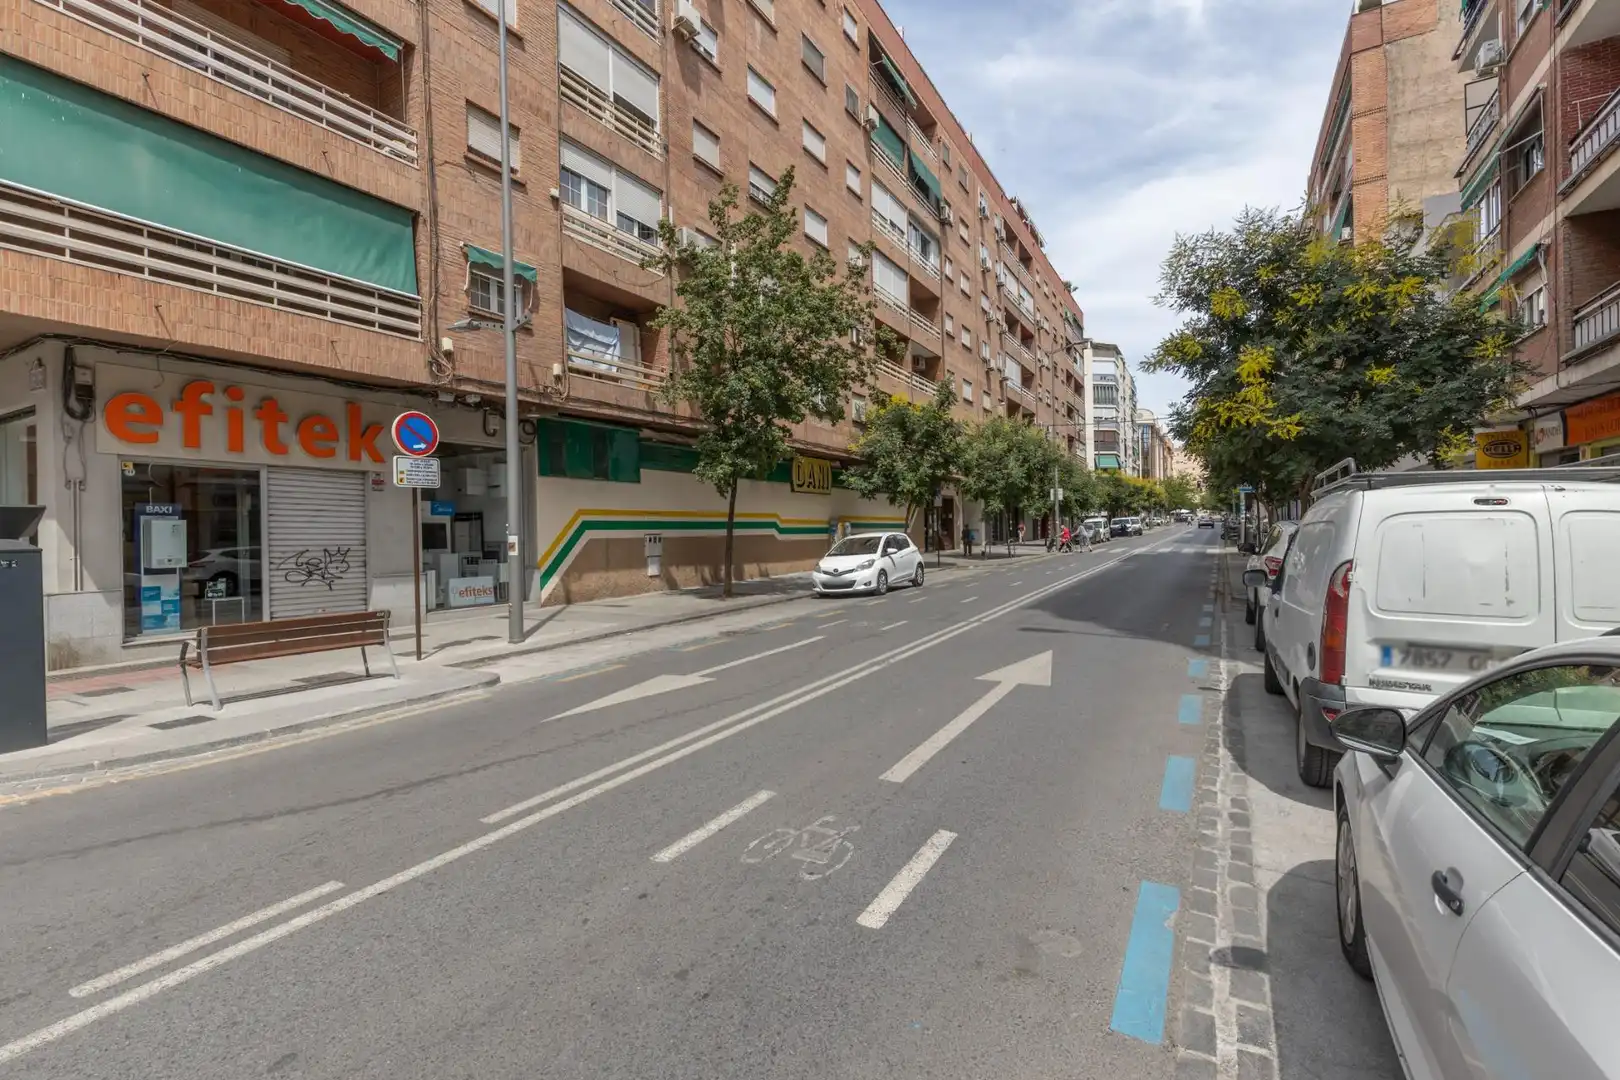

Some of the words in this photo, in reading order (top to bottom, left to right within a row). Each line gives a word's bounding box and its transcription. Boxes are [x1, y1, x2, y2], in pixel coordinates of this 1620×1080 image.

[104, 380, 386, 463] efitek
[796, 461, 829, 490] DANI
[145, 505, 173, 514] BAXI
